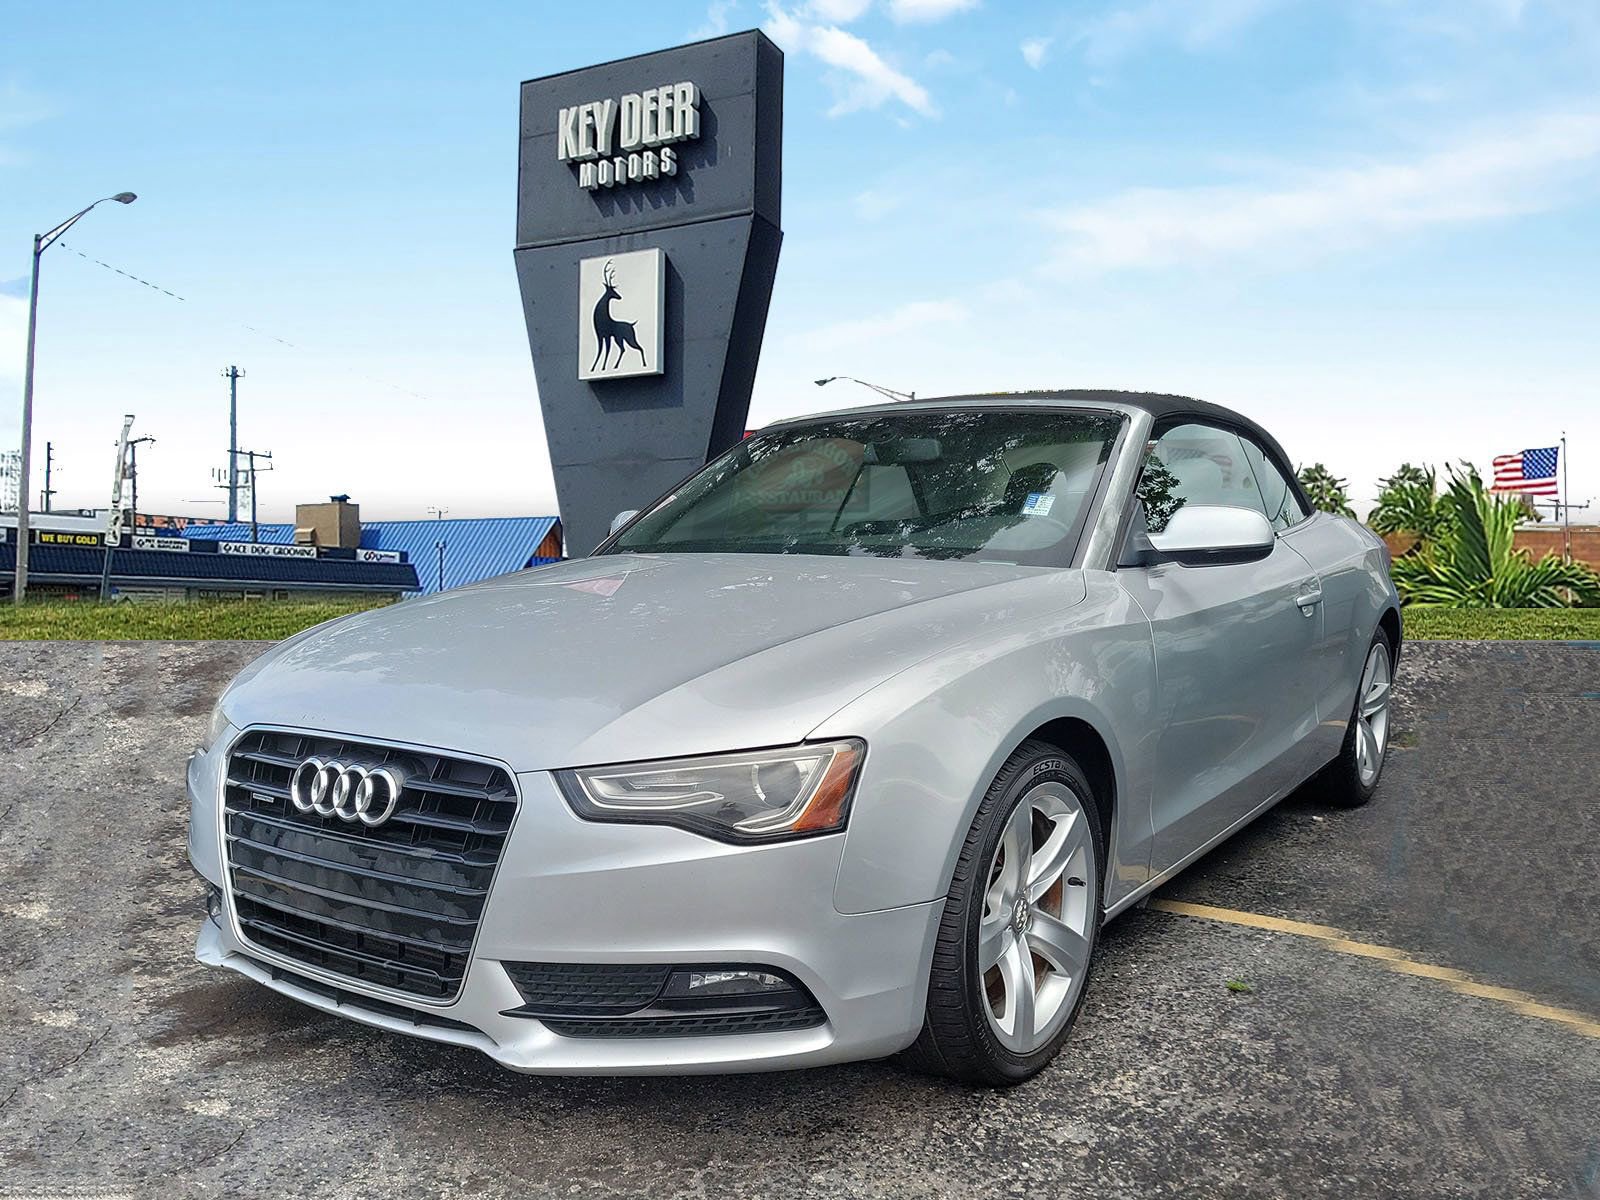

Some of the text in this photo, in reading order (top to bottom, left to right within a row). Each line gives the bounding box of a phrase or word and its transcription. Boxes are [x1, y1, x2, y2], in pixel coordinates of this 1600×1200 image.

[558, 82, 698, 160] KEY DEER
[580, 147, 675, 189] MOTORS
[41, 533, 97, 545] WE BUY GOLD
[232, 544, 315, 556] ACE DOG GROOMING
